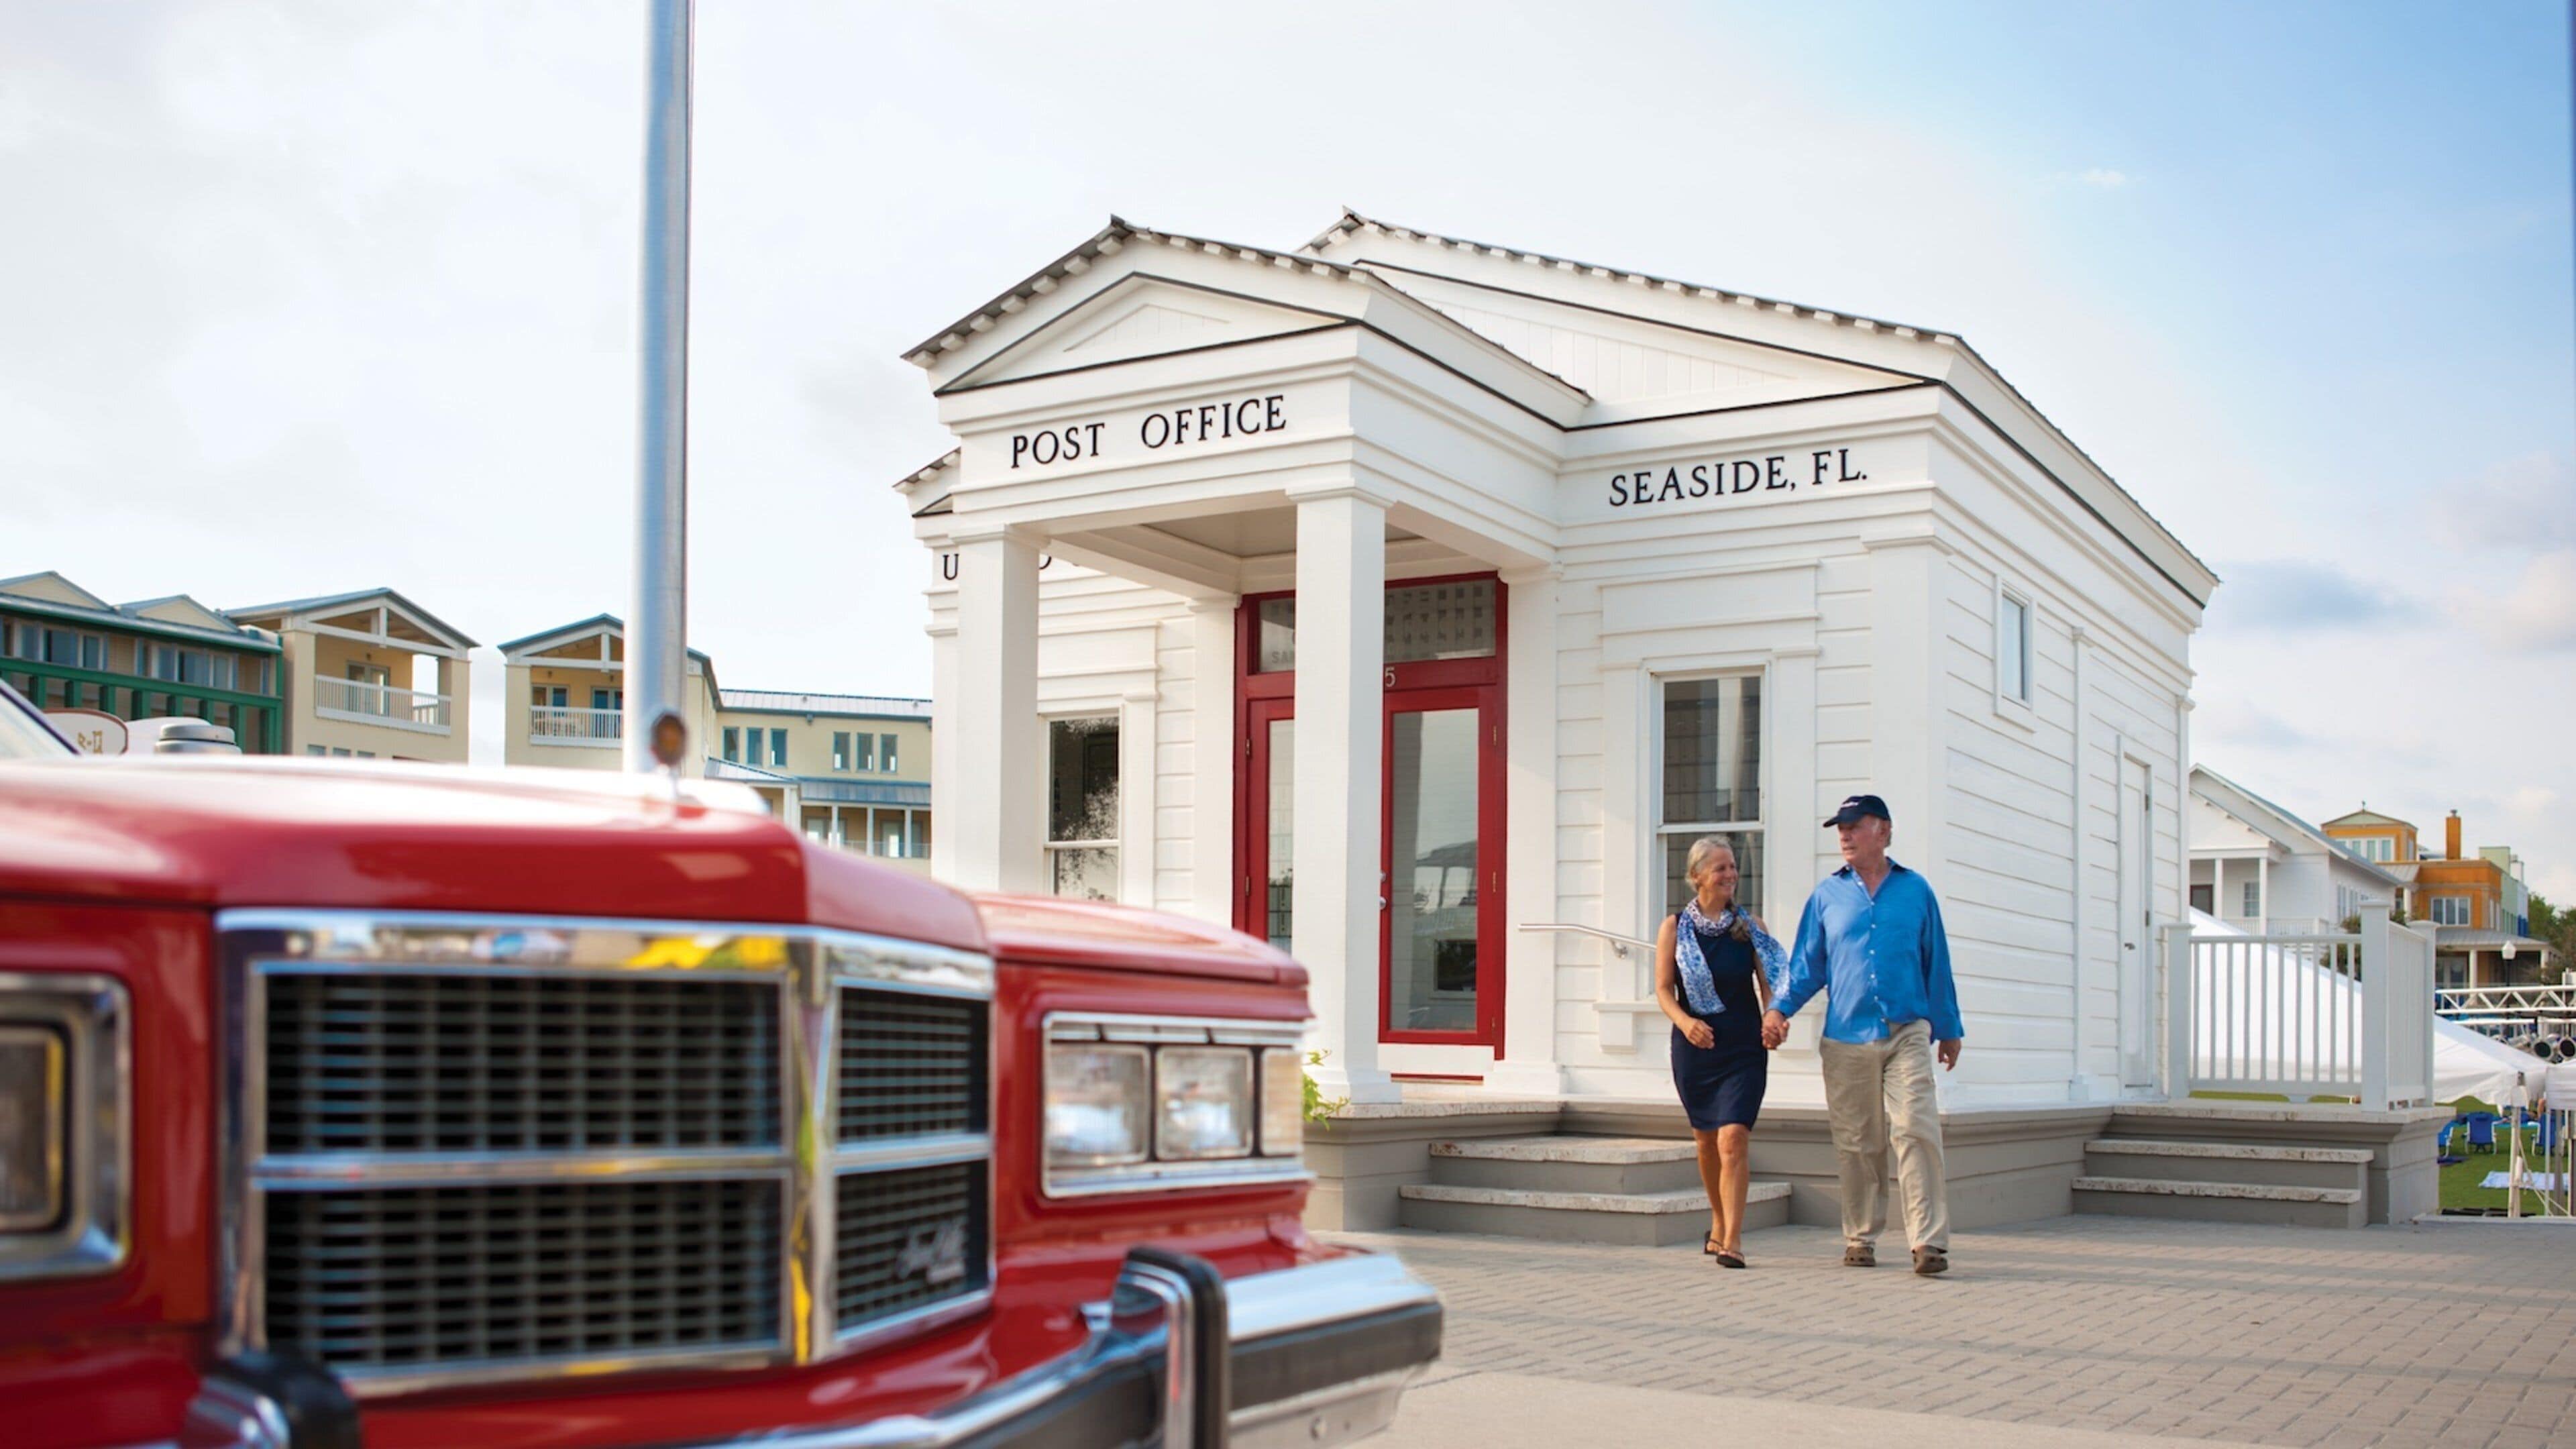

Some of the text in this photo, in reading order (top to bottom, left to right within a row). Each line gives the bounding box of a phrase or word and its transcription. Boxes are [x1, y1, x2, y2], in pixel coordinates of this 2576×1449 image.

[1010, 394, 1287, 469] POST OFFICE
[1609, 448, 1868, 507] SEASIDE, FL.
